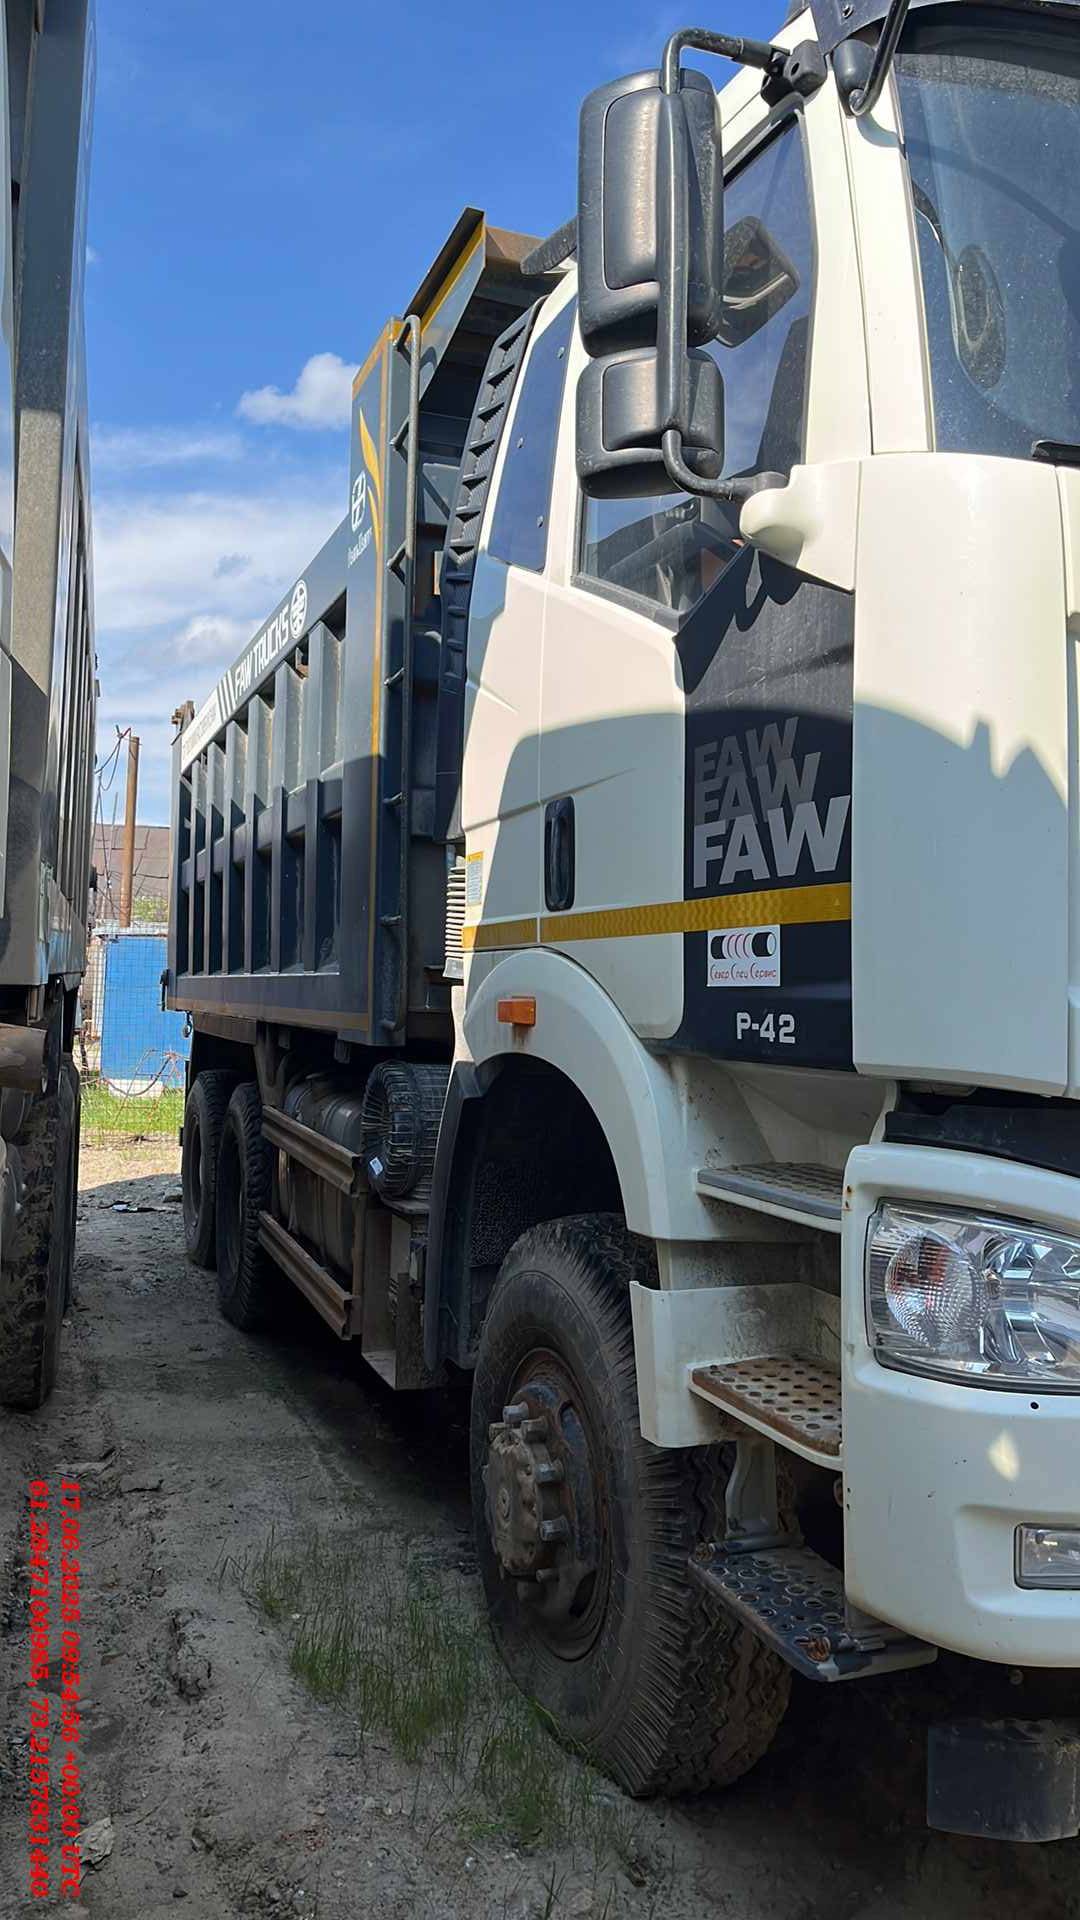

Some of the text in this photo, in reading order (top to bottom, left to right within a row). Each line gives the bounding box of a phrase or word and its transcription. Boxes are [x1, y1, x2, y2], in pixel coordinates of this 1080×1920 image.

[234, 603, 289, 701] FAW TRUCKS
[693, 795, 851, 888] FAW
